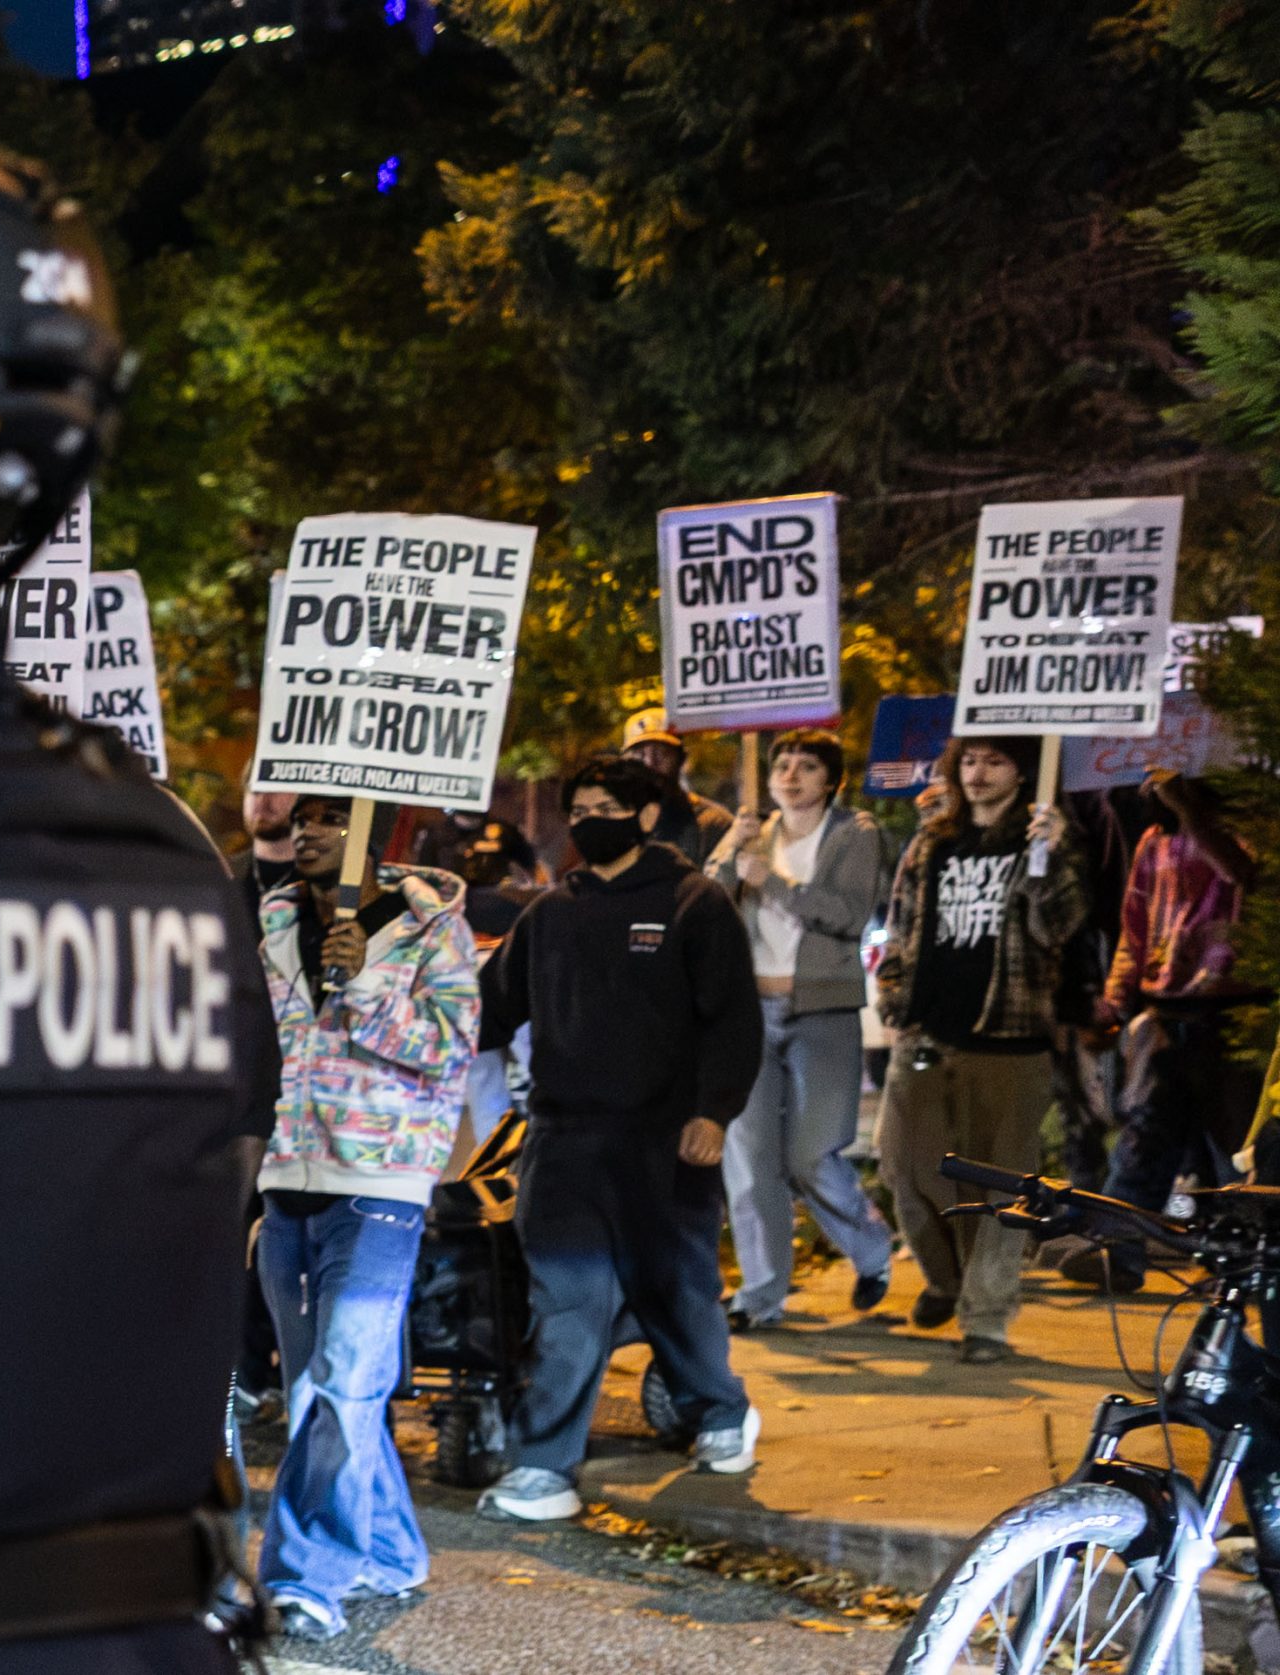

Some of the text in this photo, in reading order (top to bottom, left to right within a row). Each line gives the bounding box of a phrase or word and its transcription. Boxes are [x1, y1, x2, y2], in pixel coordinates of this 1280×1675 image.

[299, 536, 519, 581] THE PEOPLE
[679, 515, 815, 560] END
[987, 526, 1165, 559] THE PEOPLE
[408, 575, 436, 597] THE
[677, 551, 818, 607] CMPD'S
[978, 574, 1159, 621] POWER
[281, 594, 507, 662] POWER
[690, 610, 802, 653] RACIST
[981, 633, 1020, 649] TO
[280, 667, 493, 699] TO DEFEAT
[680, 644, 825, 688] POLICING
[975, 655, 1030, 695] JIM
[1035, 653, 1146, 694] CROW!
[82, 687, 147, 719] ACK
[271, 695, 488, 761] JIM CROW!
[270, 762, 331, 782] JUSTICE
[332, 765, 363, 785] FOR
[938, 853, 1017, 887] AMY
